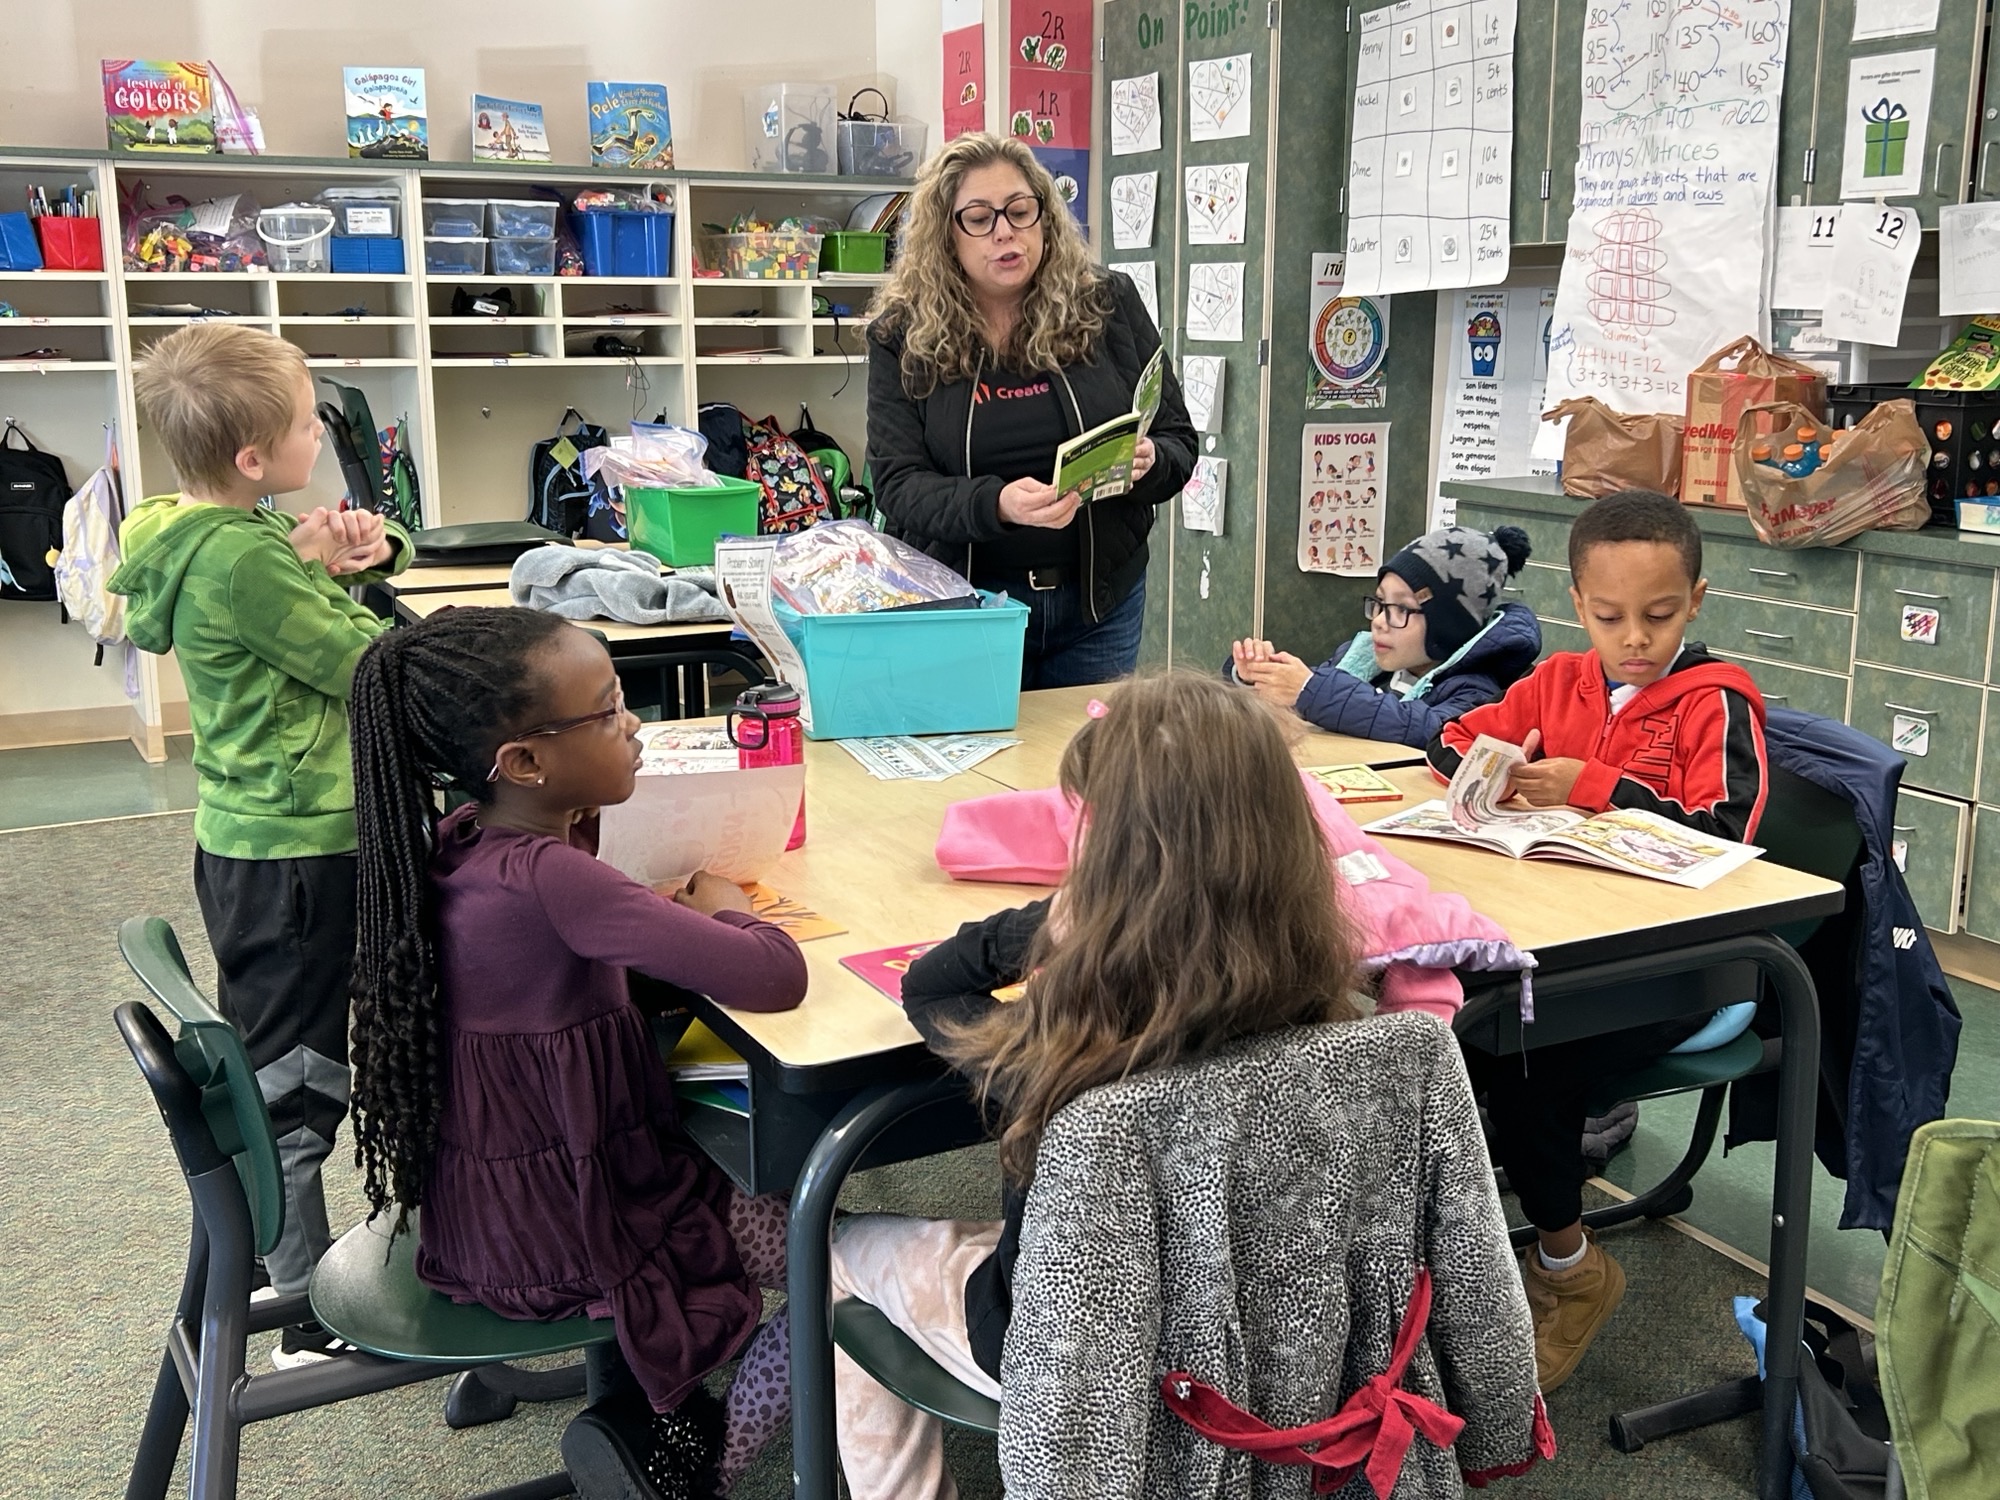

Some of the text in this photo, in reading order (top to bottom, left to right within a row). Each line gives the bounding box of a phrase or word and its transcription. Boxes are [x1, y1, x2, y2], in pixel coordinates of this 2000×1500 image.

[1041, 11, 1065, 40] 2R
[1138, 0, 1249, 49] On Point!
[1362, 13, 1381, 27] Name
[1484, 14, 1498, 33] 1¢
[1590, 9, 1608, 25] 80
[1676, 25, 1708, 46] 135
[1744, 20, 1775, 42] 160
[1361, 41, 1383, 59] Penny
[1483, 35, 1499, 47] cent
[1587, 38, 1607, 60] 85
[958, 51, 972, 75] 2R
[1487, 62, 1500, 80] 5¢
[402, 75, 417, 87] Girl
[1673, 70, 1700, 92] 140
[1740, 61, 1775, 87] 165
[174, 79, 187, 91] of
[1476, 83, 1508, 104] 5 cents
[1585, 75, 1606, 96] 90
[114, 87, 202, 114] COLORS
[591, 93, 621, 119] Pelé
[1036, 90, 1060, 117] 1R
[1356, 92, 1379, 108] Nickel
[1482, 146, 1498, 165] 10¢
[1351, 161, 1372, 178] Dime
[1485, 172, 1504, 185] cents
[1579, 177, 1597, 193] They
[1650, 167, 1688, 188] objects
[1695, 166, 1729, 183] that
[1737, 172, 1758, 183] are
[1663, 185, 1687, 202] and
[1479, 224, 1498, 242] 25¢
[1812, 211, 1904, 240] 11 12
[1349, 237, 1380, 253] Quarter
[1802, 332, 1833, 346] Tuesday
[996, 382, 1050, 399] Create
[1463, 393, 1474, 401] son
[1314, 433, 1376, 446] KIDS YOGA
[1451, 451, 1464, 460] son
[1455, 463, 1469, 471] dan
[1693, 479, 1728, 487] REUSABLE
